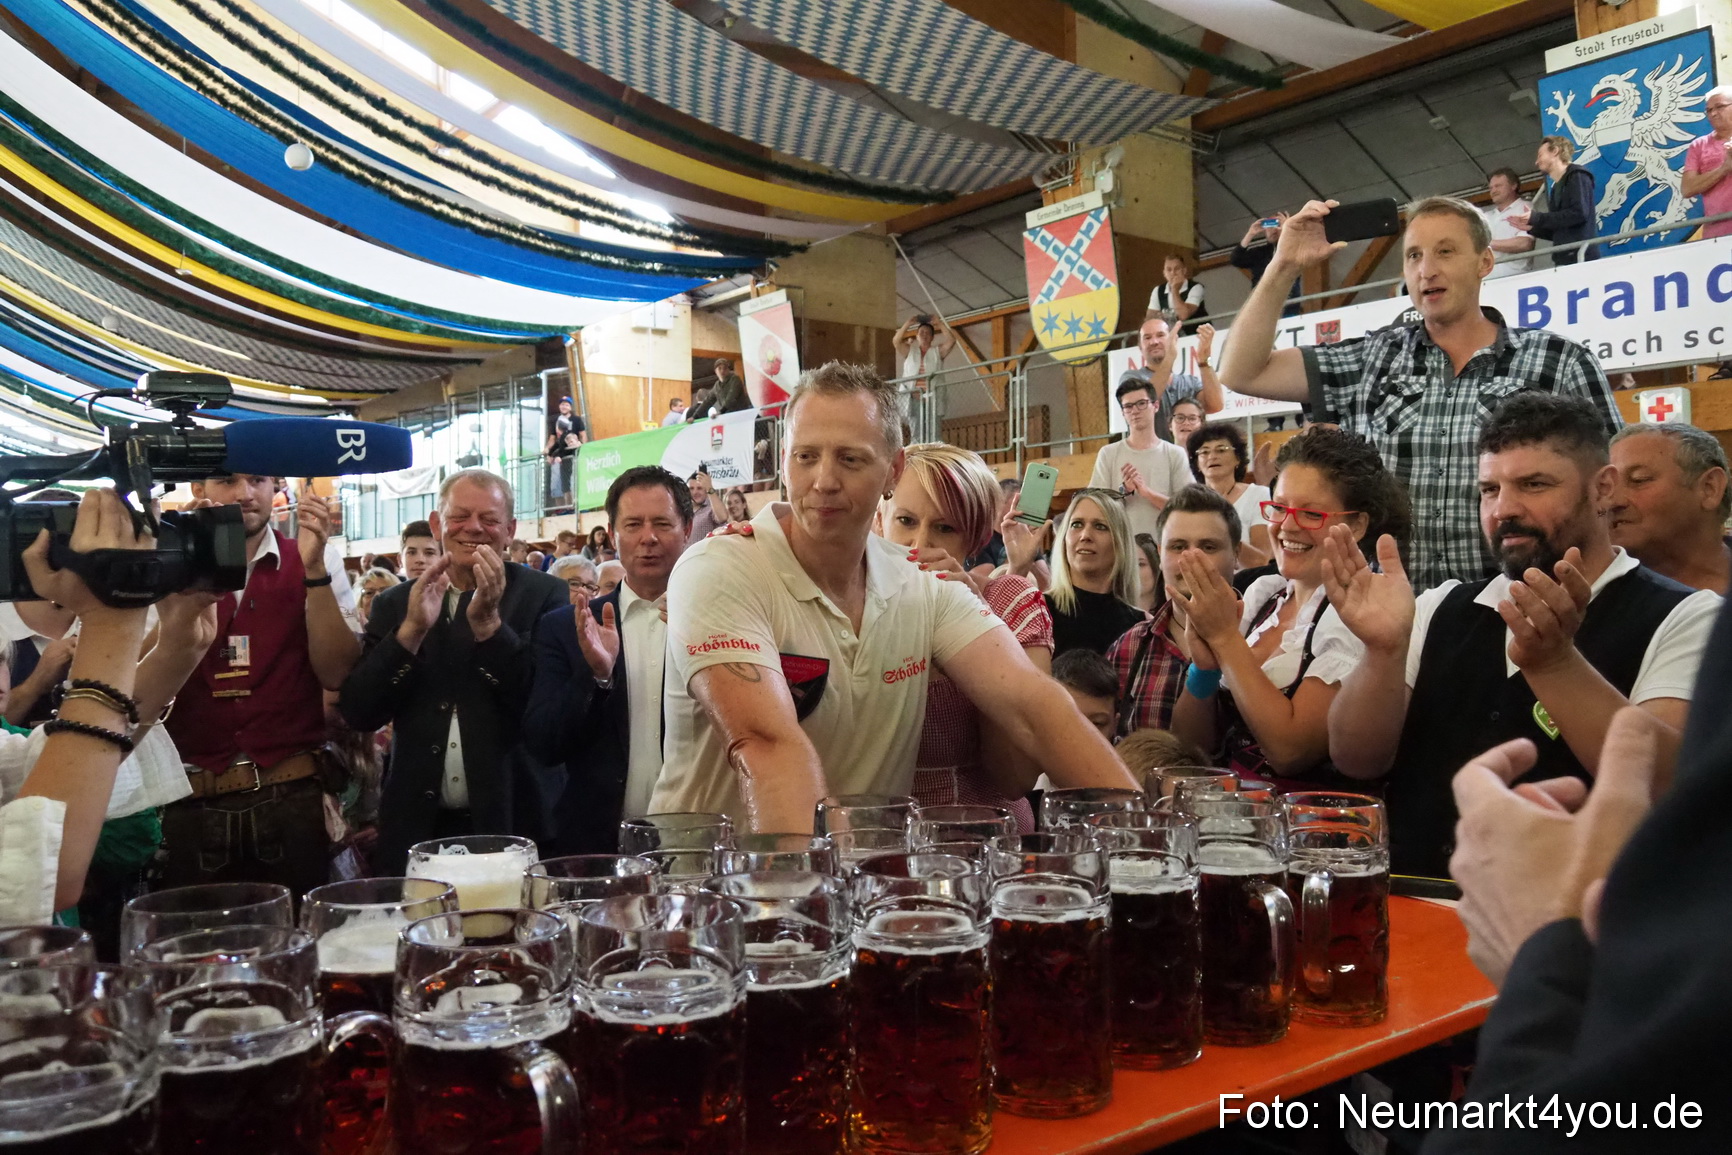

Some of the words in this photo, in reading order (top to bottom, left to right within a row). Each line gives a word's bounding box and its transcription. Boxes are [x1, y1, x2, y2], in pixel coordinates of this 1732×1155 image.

[1574, 41, 1605, 57] Stadt
[1610, 23, 1665, 46] Freystadt
[335, 428, 367, 465] BR
[586, 450, 621, 472] Herzlich
